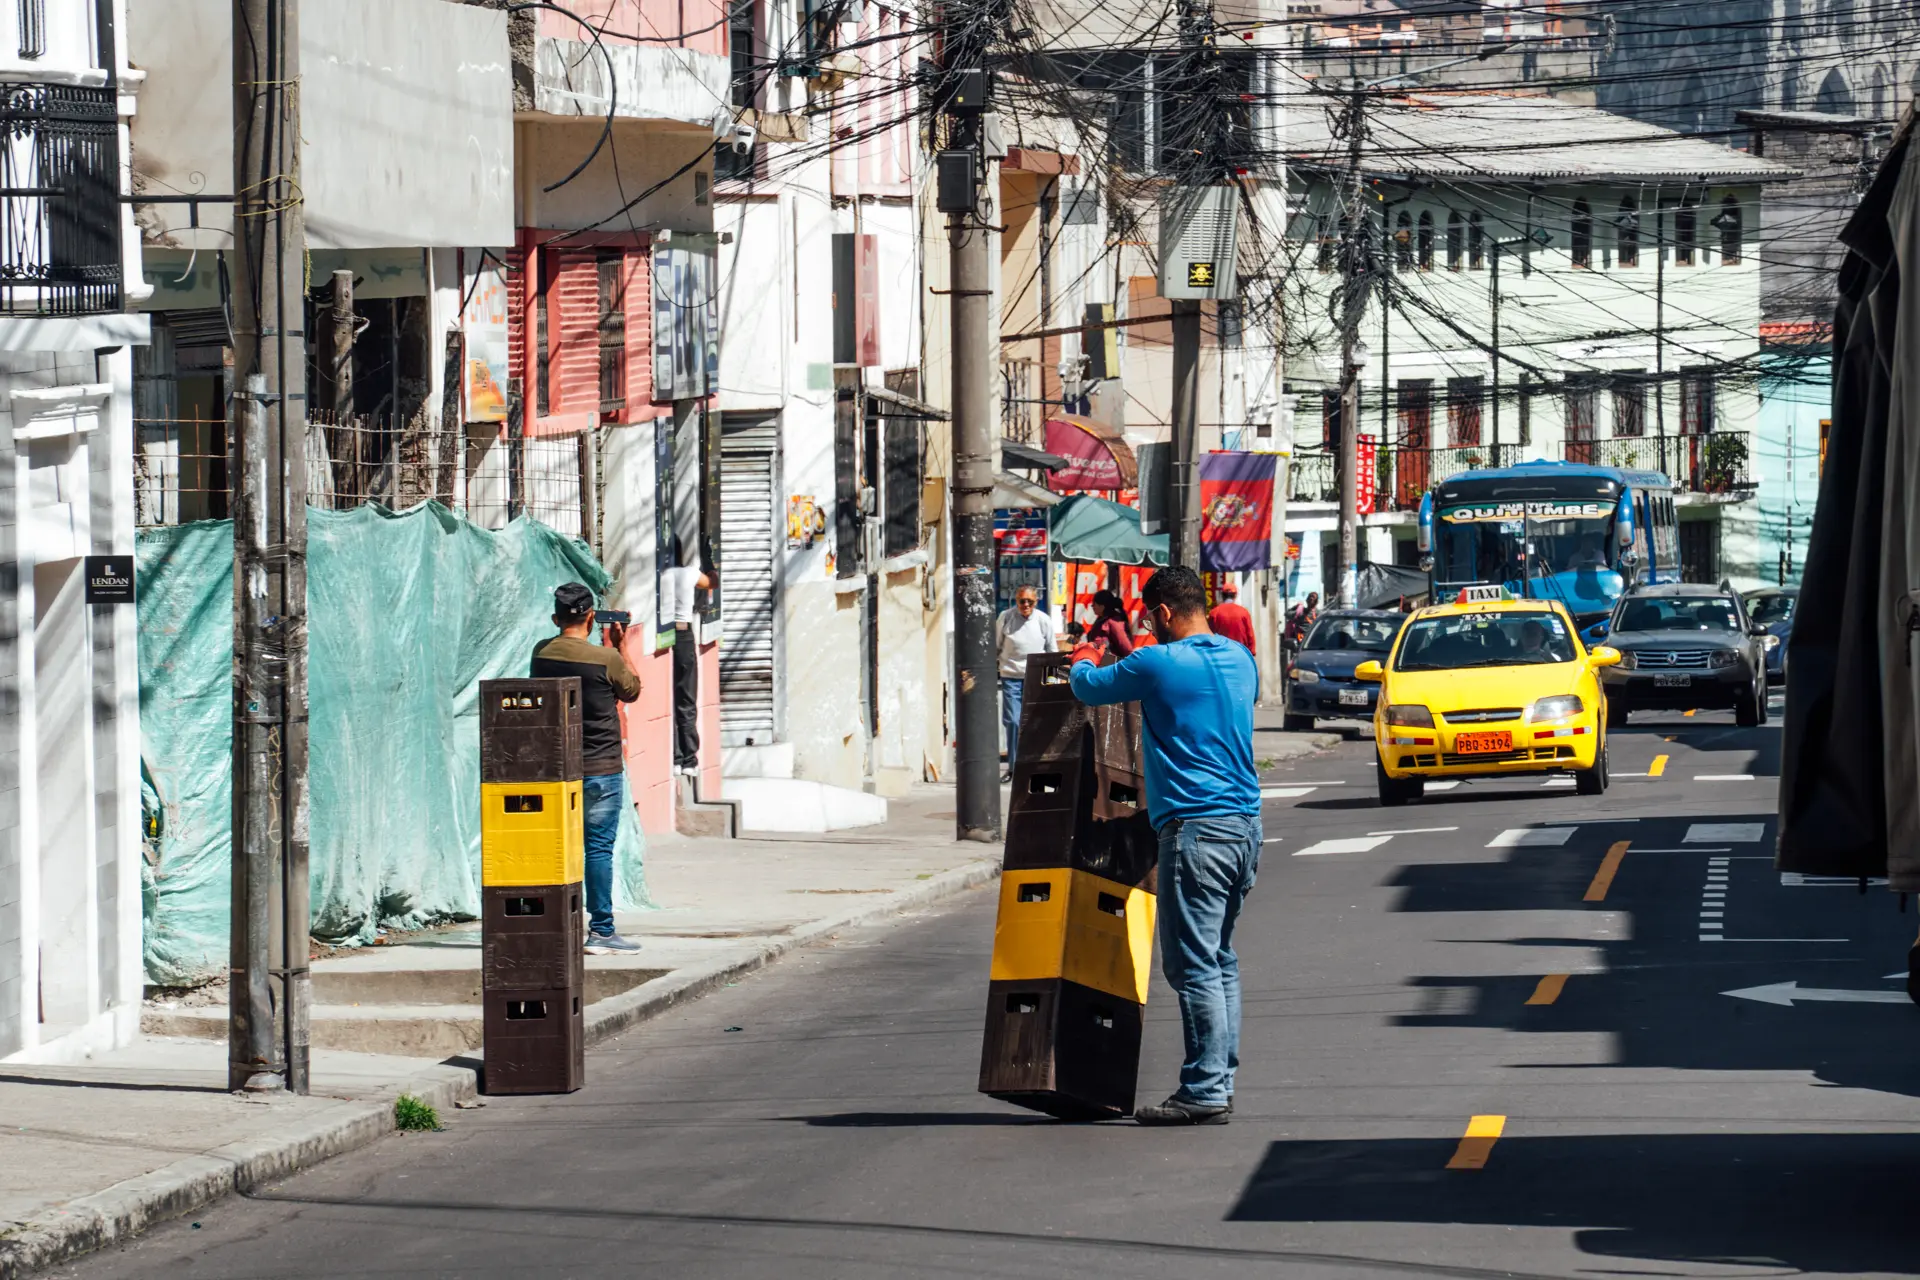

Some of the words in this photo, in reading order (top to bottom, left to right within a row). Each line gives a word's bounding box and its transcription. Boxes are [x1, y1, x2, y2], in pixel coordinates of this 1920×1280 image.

[1453, 504, 1598, 520] QUITUMBE
[91, 577, 129, 585] LENDAN
[1467, 587, 1500, 600] TAXI
[1462, 612, 1502, 621] TAXI
[1458, 738, 1511, 752] PBQ-3194
